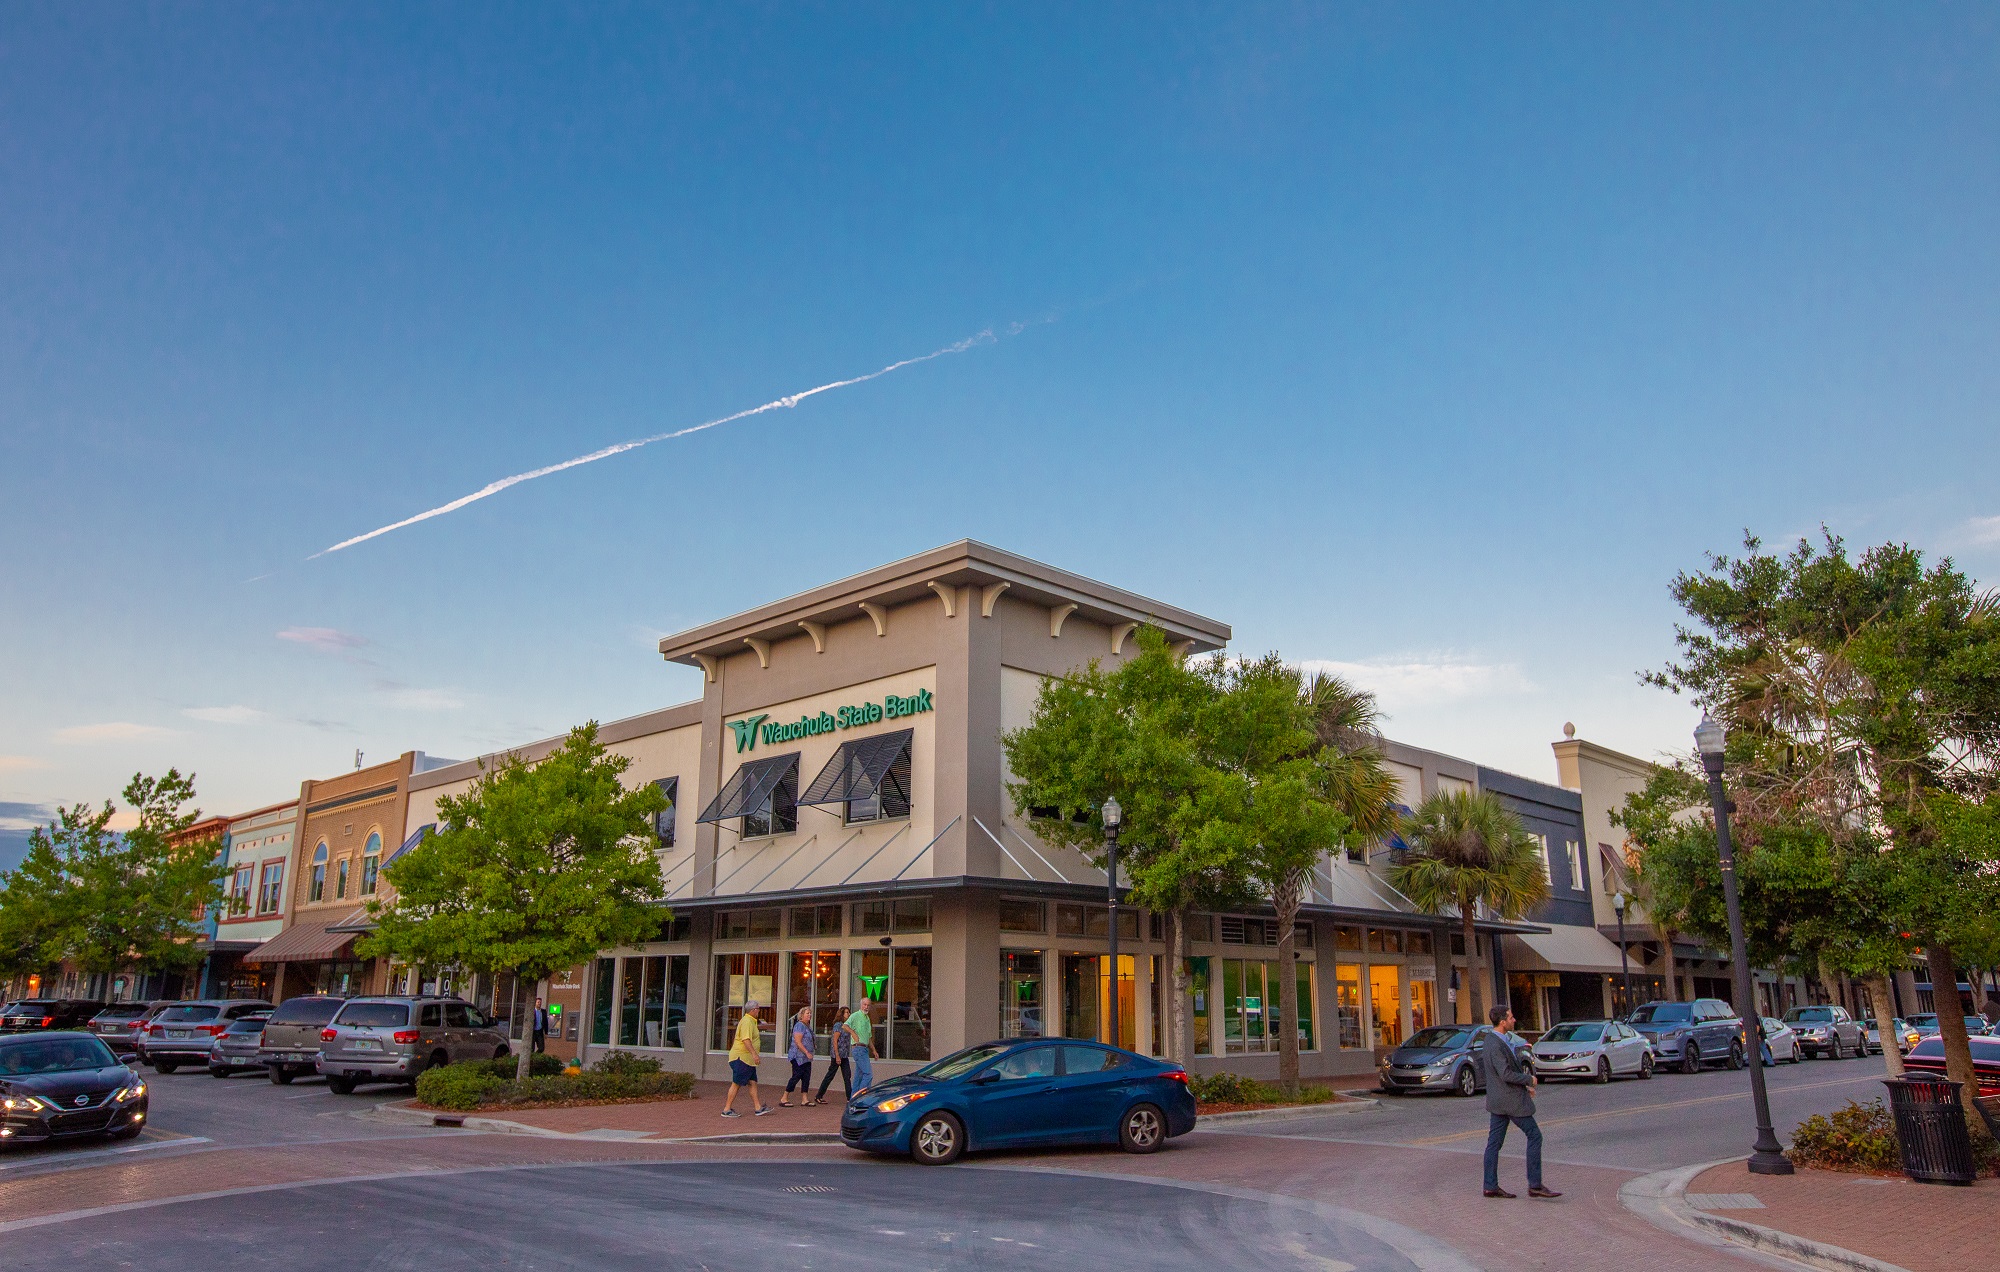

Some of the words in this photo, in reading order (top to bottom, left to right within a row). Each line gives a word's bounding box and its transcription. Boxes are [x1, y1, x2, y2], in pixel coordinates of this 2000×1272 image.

[761, 711, 835, 744] Wauchula
[836, 702, 883, 730] State
[885, 688, 933, 719] Bank
